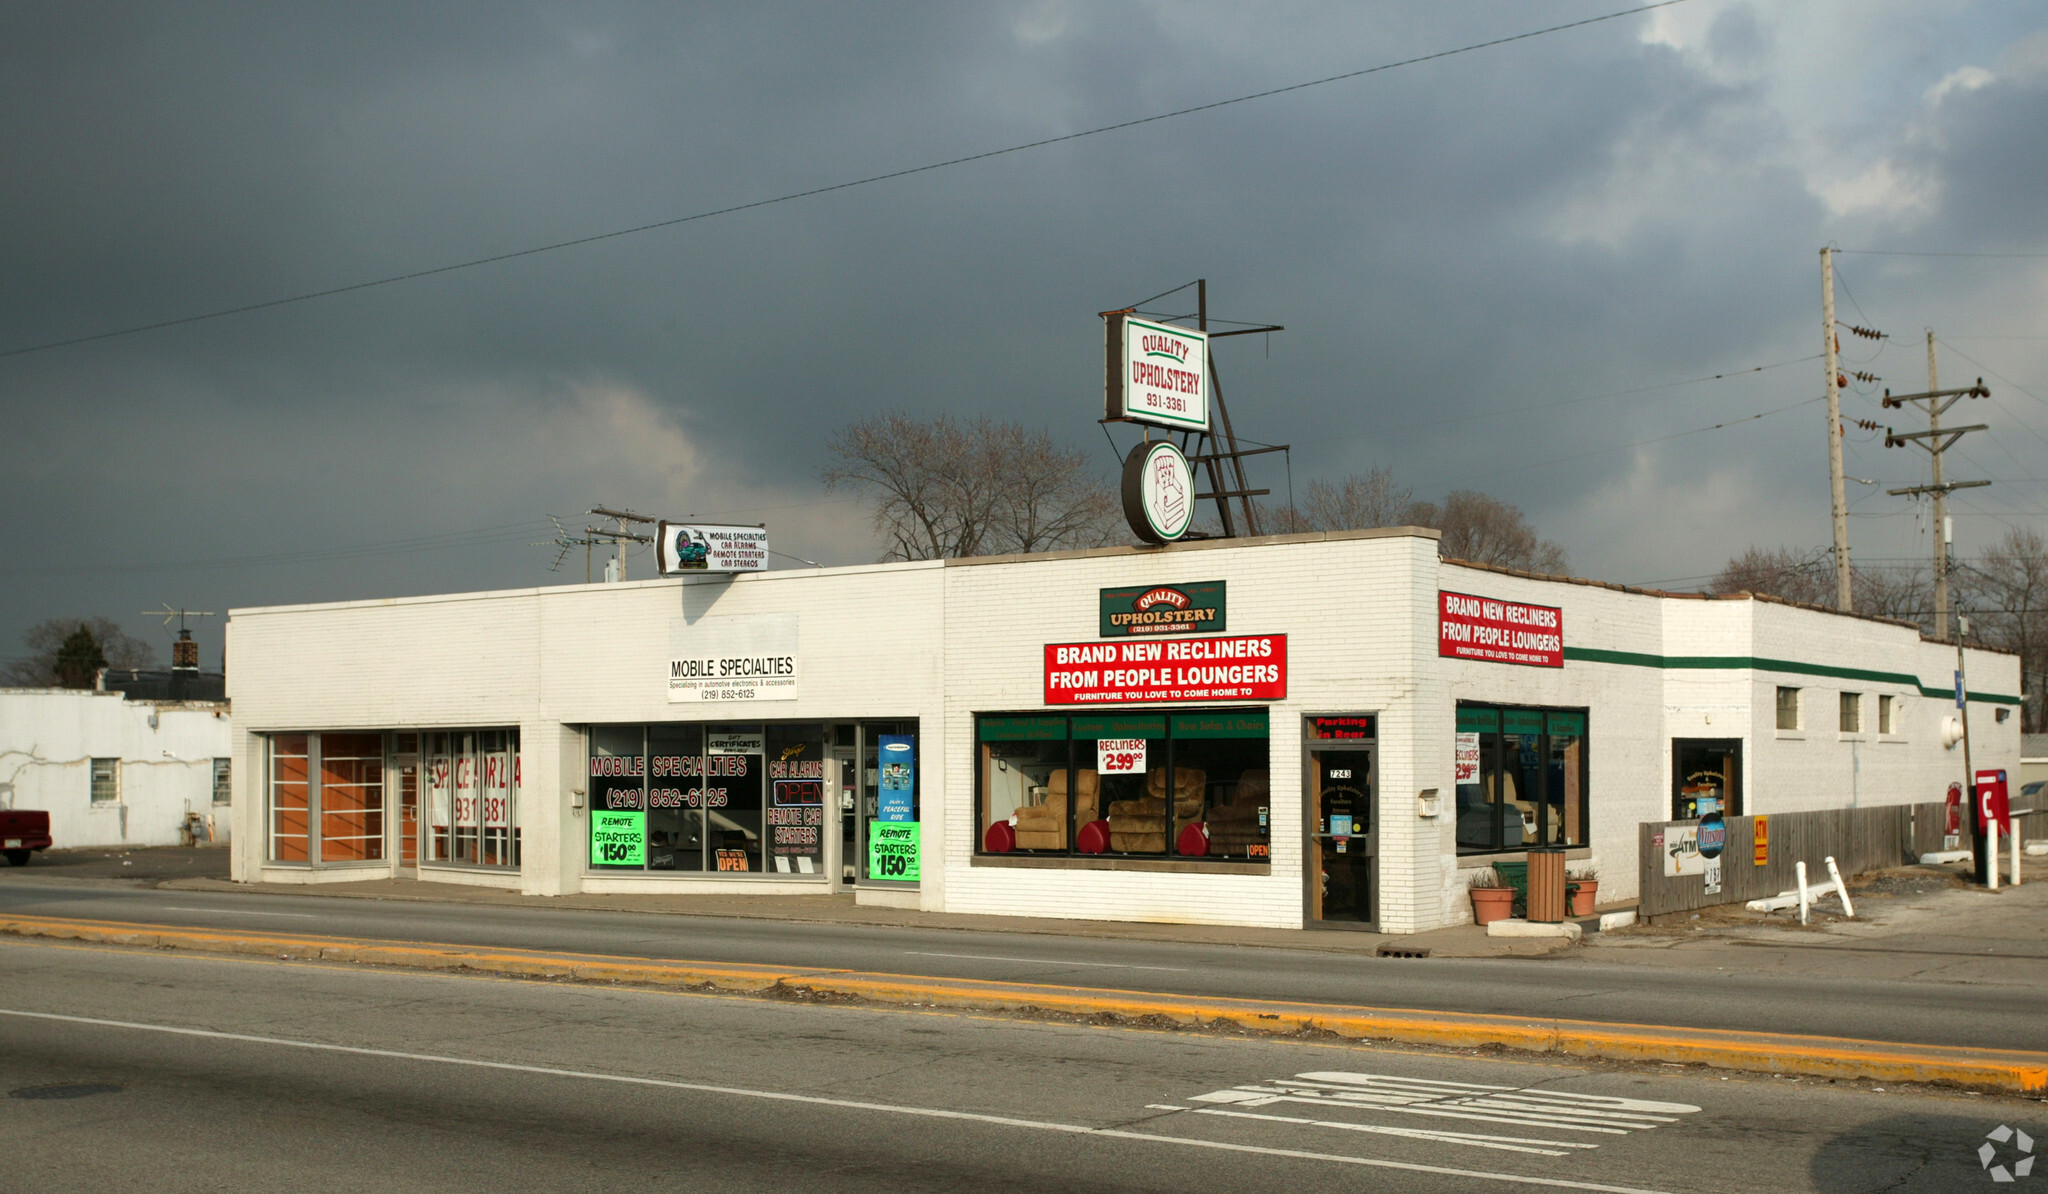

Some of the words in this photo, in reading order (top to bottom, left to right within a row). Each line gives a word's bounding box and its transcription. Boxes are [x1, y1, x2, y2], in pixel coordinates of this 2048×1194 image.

[1142, 334, 1189, 360] QUALITY
[1132, 360, 1200, 395] UPHOLSTERY
[1146, 392, 1186, 412] 931-3361
[710, 532, 732, 540] MOBILE
[733, 532, 766, 542] SPECIALTIES
[720, 541, 732, 549] CAR
[734, 542, 756, 550] ALARMS
[713, 550, 737, 558] REMOTE
[738, 551, 764, 559] STARTERS
[734, 560, 758, 568] STEREOS
[1140, 591, 1186, 608] QUALITY
[1111, 608, 1216, 626] UPHOLSTERY
[1446, 596, 1480, 618] BRAND
[1482, 602, 1504, 621] NEW
[1506, 605, 1556, 628] RECLINERS
[1132, 625, 1152, 633] (219)
[1154, 624, 1190, 632] 931-3361
[1442, 622, 1471, 642] FROM
[1474, 626, 1510, 646] PEOPLE
[1512, 630, 1560, 652] LOUNGERS
[1056, 646, 1117, 664] BRAND
[1122, 644, 1161, 662] NEW
[1168, 639, 1272, 660] RECLINERS
[1456, 646, 1484, 656] FURNITURE
[1485, 649, 1494, 658] YOU
[1496, 650, 1508, 659] LOVE
[1508, 652, 1514, 660] TO
[1516, 652, 1528, 662] COME
[1529, 654, 1542, 662] HOME
[1542, 655, 1548, 663] TO
[672, 660, 714, 678] MOBILE
[720, 656, 793, 676] SPECIALTIES
[1050, 671, 1098, 689] FROM
[1104, 668, 1172, 687] PEOPLE
[1178, 664, 1278, 685] LOUNGERS
[670, 681, 698, 690] Specializing
[702, 690, 718, 700] (219)
[721, 689, 754, 699] 852-6125
[1074, 692, 1122, 700] FURNITURE
[1125, 691, 1142, 699] YOU
[1184, 689, 1209, 698] COME
[1211, 688, 1238, 696] HOME
[1240, 688, 1252, 696] TO
[1317, 718, 1367, 728] Parking
[1319, 730, 1331, 738] in
[1335, 730, 1364, 738] Rear
[1100, 739, 1146, 750] RECLINERS
[590, 756, 644, 776] MOBILE
[652, 756, 747, 776] SPECIALTIES
[770, 760, 788, 778] CAR
[789, 760, 822, 778] ALARMS
[1330, 770, 1351, 778] 7243
[606, 788, 644, 809] (219)
[650, 788, 728, 807] 852-6125
[776, 782, 824, 803] OPEN
[601, 817, 634, 826] REMOTE
[768, 808, 802, 825] REMOTE
[804, 808, 822, 826] CAR
[594, 832, 642, 843] STARTERS
[775, 828, 818, 844] STARTERS
[880, 829, 912, 838] REMOTE
[874, 844, 917, 855] STARTERS
[1249, 844, 1268, 856] OPEN
[719, 858, 747, 871] OPEN
